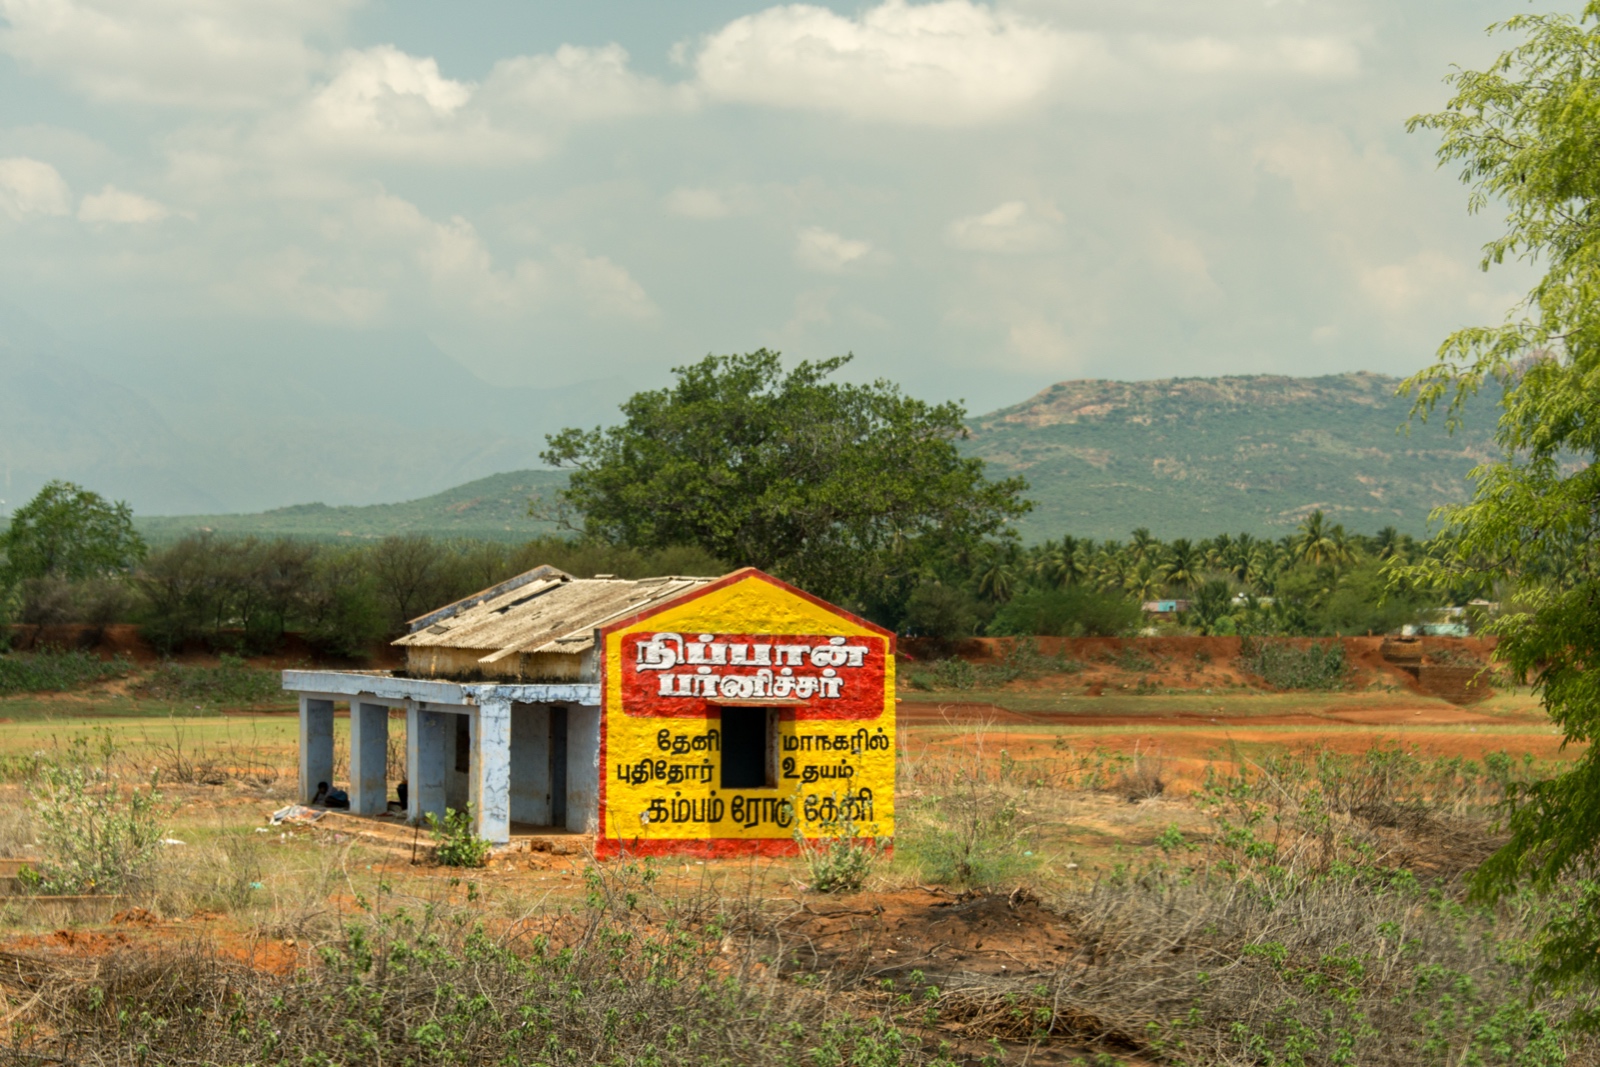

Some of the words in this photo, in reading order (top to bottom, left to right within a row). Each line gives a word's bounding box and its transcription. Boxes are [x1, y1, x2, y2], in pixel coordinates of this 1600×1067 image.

[657, 666, 844, 698] பர்னிச்சர்
[657, 729, 720, 755] தேனி
[782, 727, 890, 755] மாநகரில்
[617, 758, 715, 786] புதிதோர்
[782, 757, 855, 784] உதயம்
[645, 790, 725, 823] கம்பம்
[731, 795, 794, 829] ரோடு
